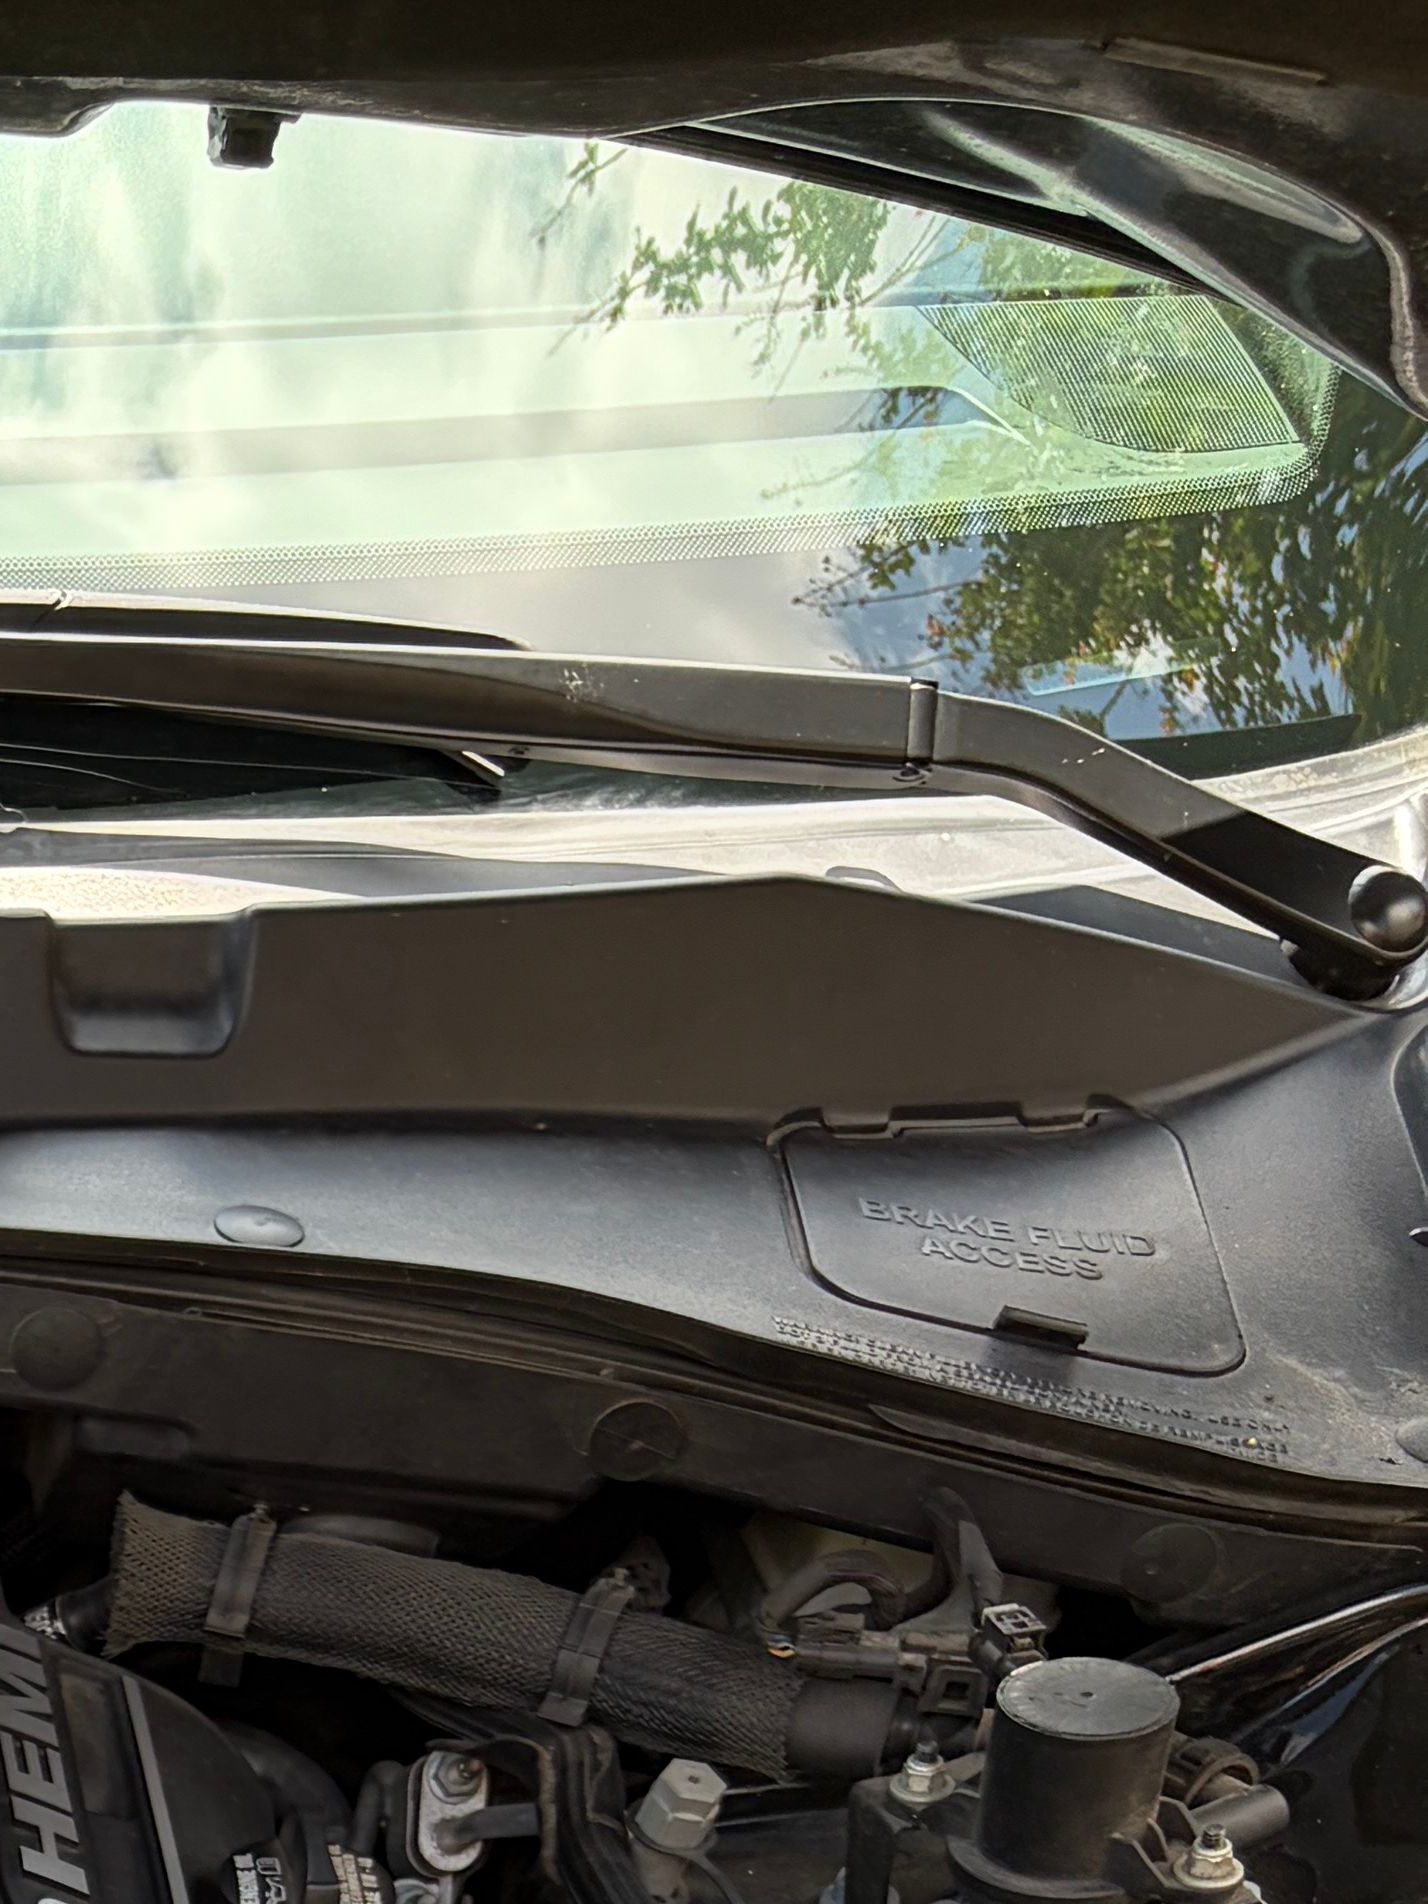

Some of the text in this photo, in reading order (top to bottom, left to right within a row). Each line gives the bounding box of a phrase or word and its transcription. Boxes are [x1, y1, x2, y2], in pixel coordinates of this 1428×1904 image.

[859, 1199, 1156, 1258] BRAKE FLUID
[920, 1239, 1103, 1281] ACCESS
